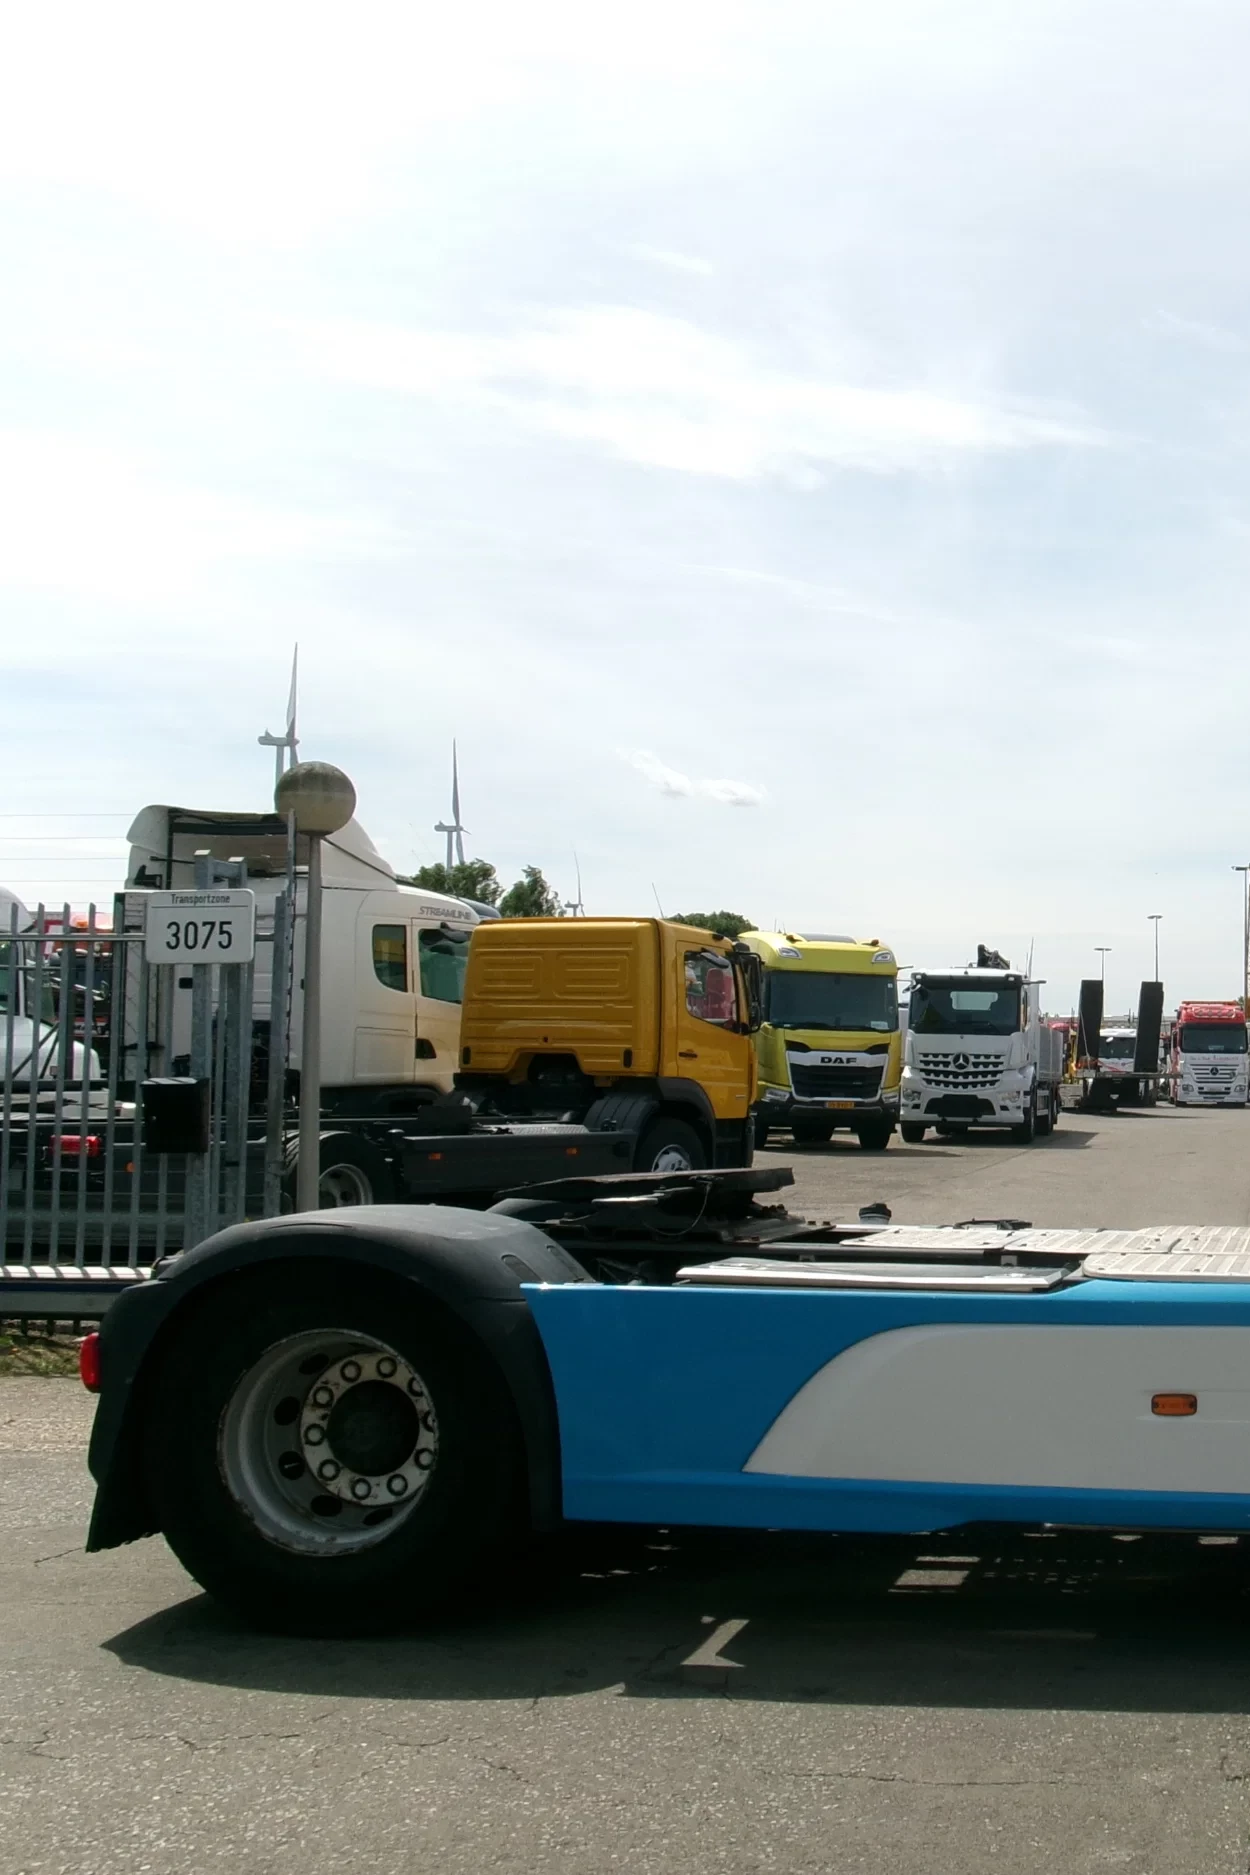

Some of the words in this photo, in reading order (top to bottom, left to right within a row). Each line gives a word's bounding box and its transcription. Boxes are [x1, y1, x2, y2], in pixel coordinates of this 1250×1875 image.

[171, 893, 231, 906] Transportzone
[418, 905, 472, 921] STREAMLINE
[166, 920, 233, 950] 3075
[820, 1056, 857, 1065] DAF
